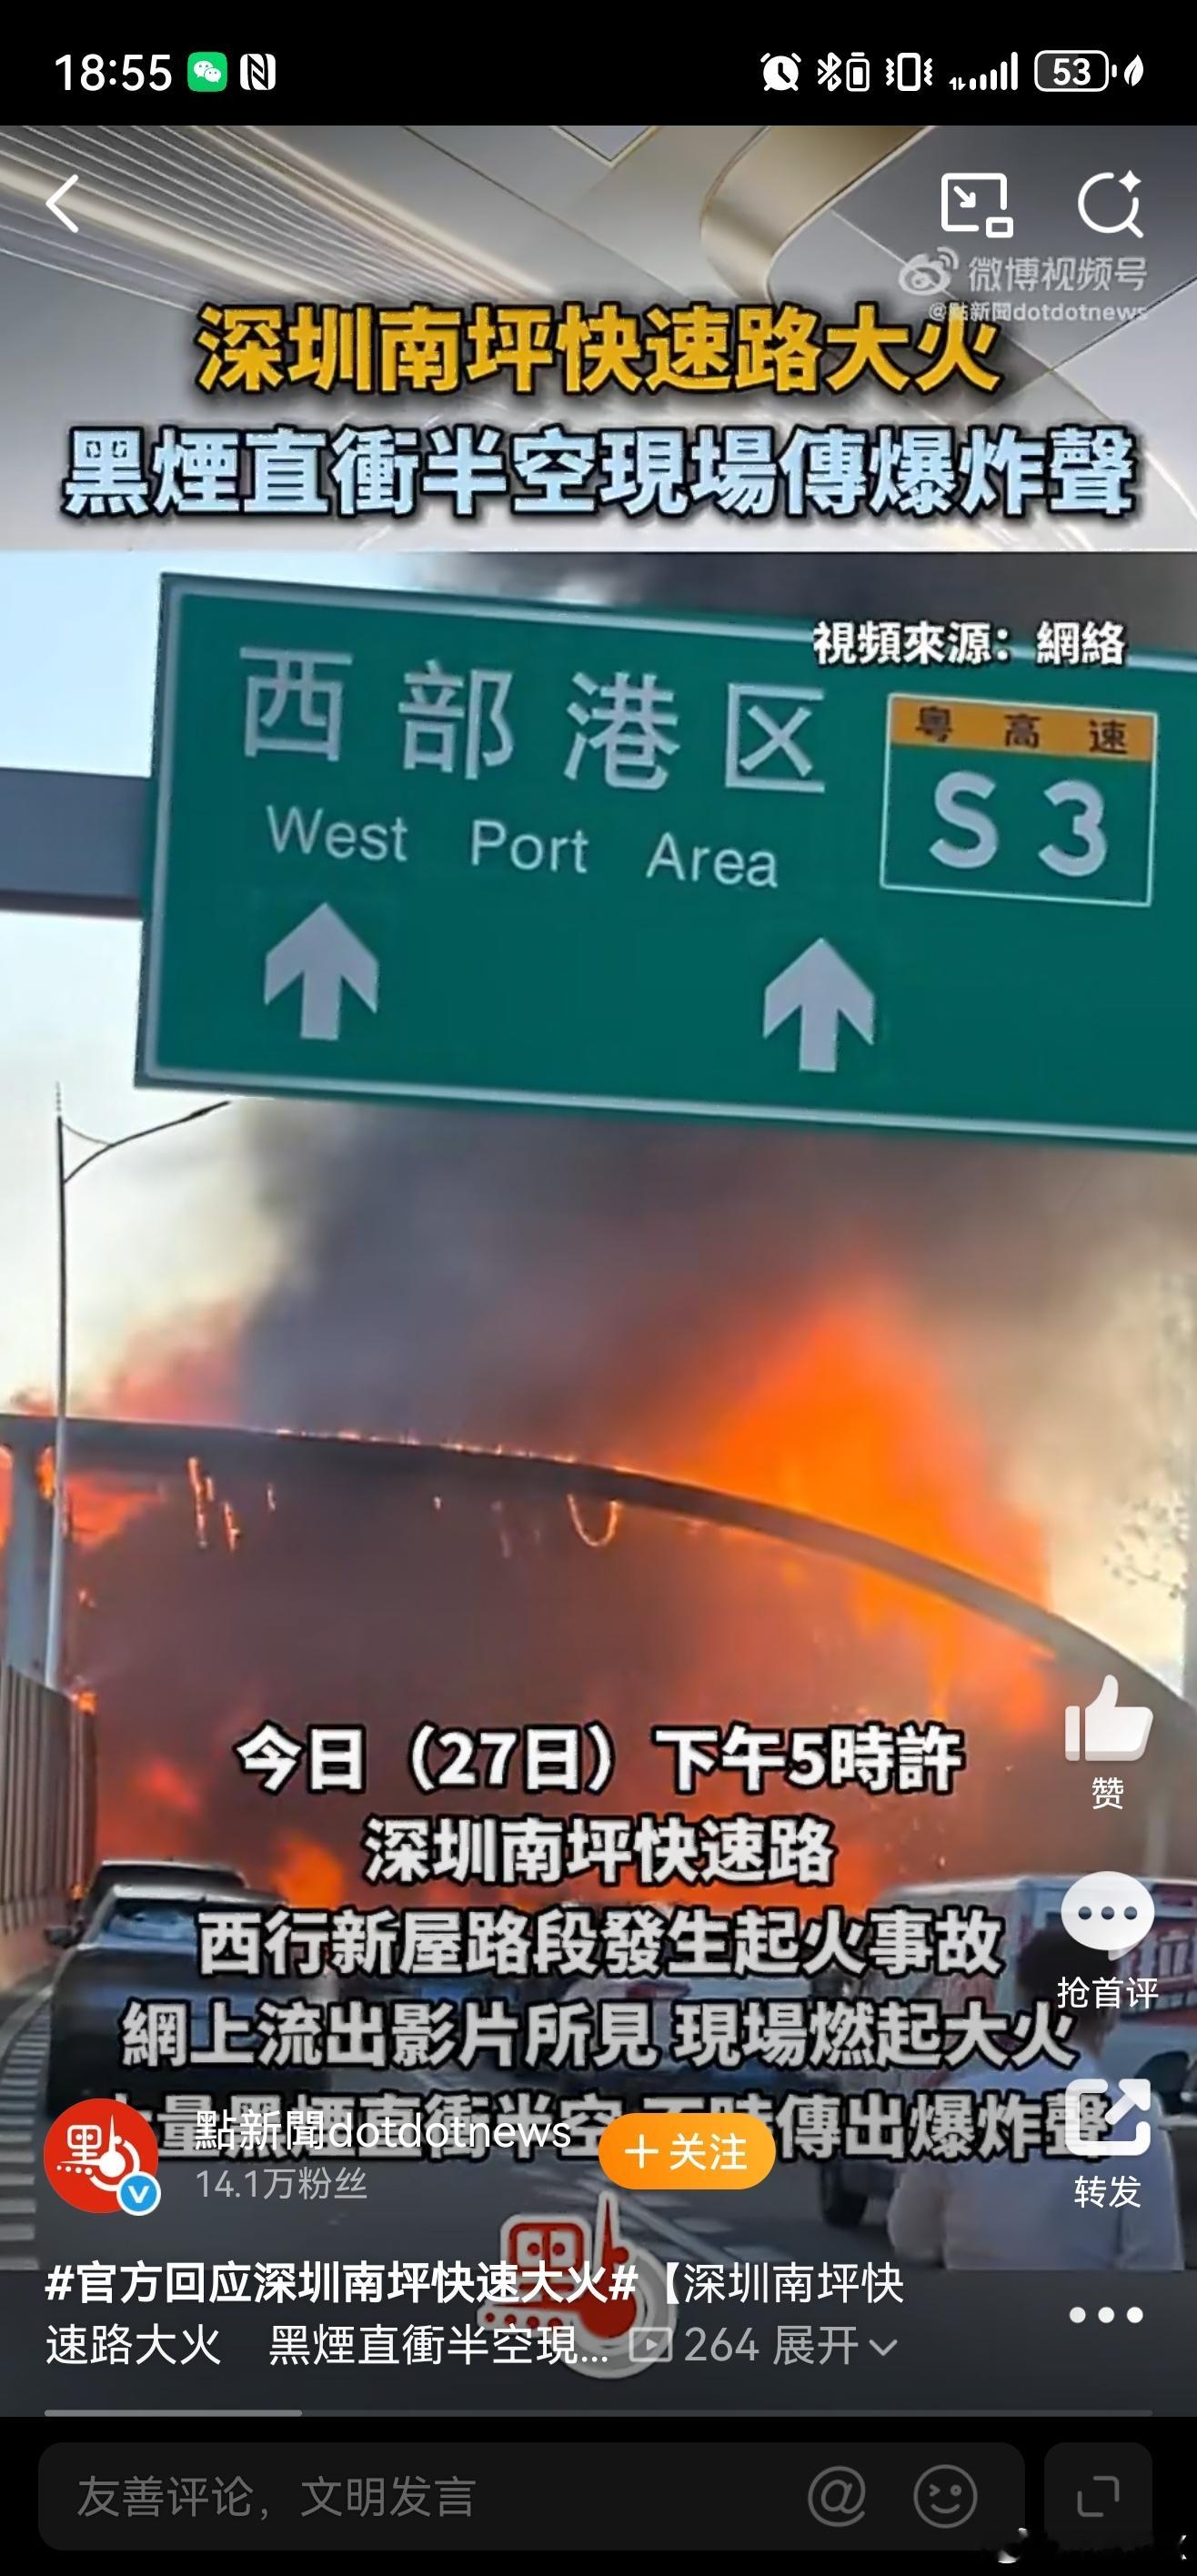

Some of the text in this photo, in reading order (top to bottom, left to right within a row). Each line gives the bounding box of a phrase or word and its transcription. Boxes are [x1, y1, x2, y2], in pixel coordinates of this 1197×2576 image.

[238, 645, 827, 794] 西部港区
[915, 706, 1128, 755] 粤高速
[266, 804, 779, 890] West Port Area
